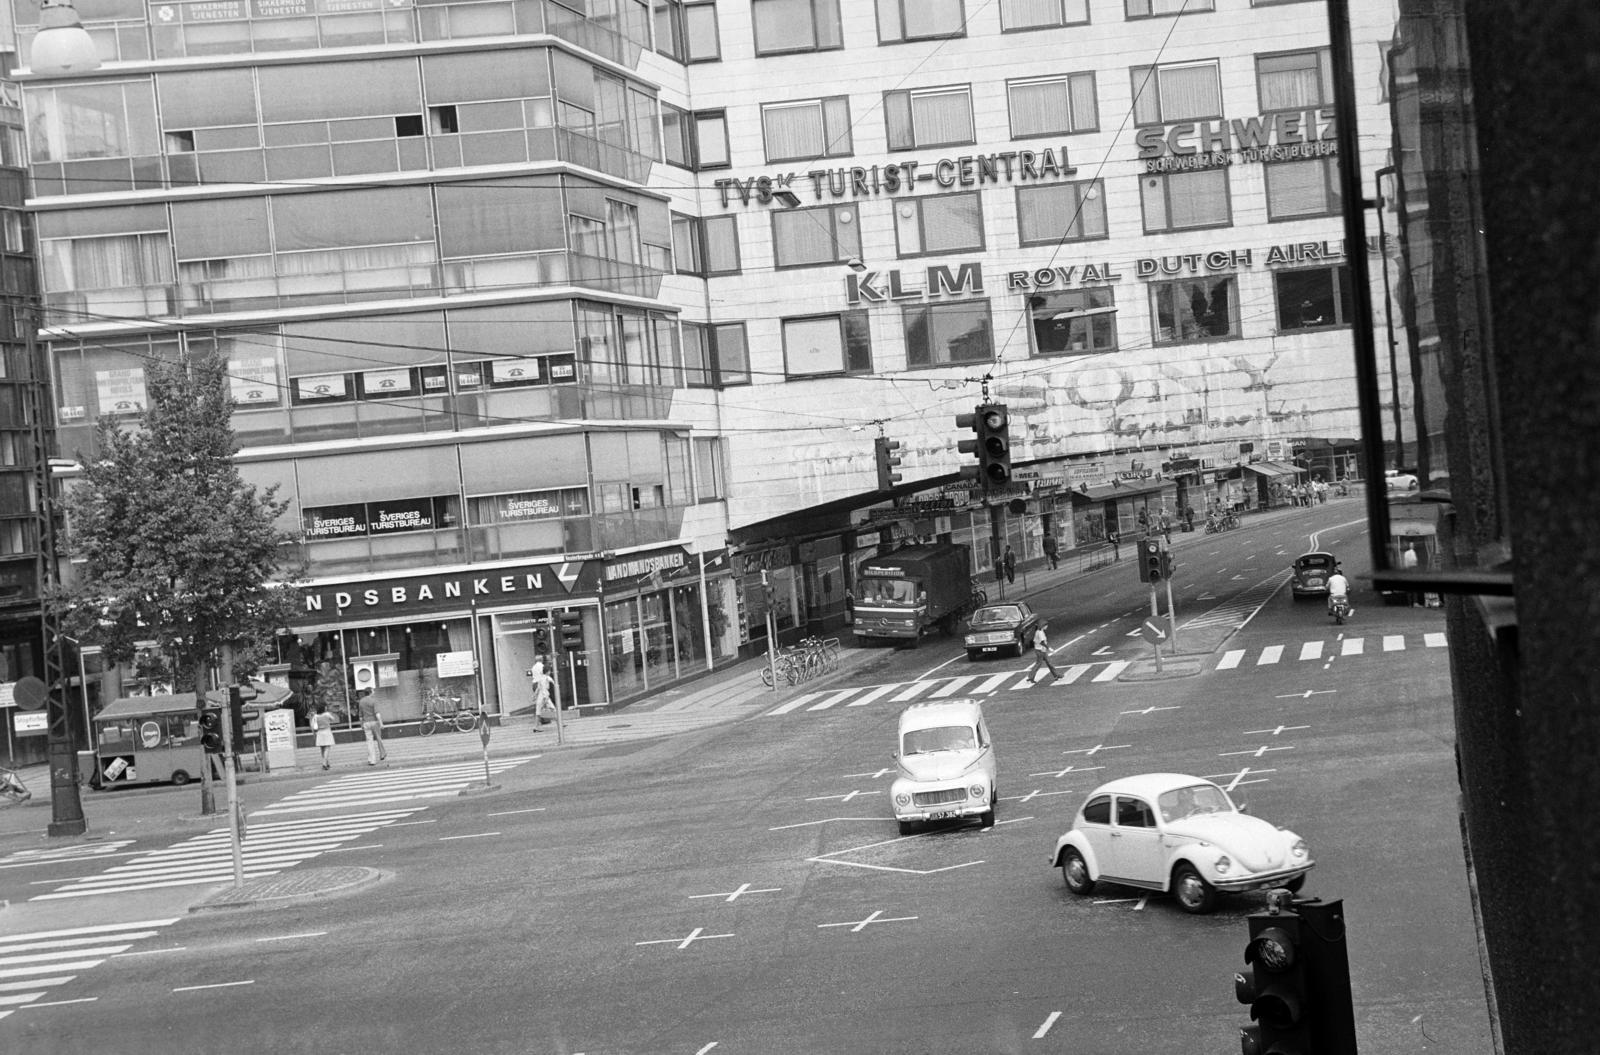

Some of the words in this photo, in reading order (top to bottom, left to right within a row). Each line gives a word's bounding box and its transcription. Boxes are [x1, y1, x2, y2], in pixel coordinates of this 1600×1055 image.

[1136, 110, 1338, 158] SCHWEIZ
[1147, 153, 1235, 172] SCHWEIZISK
[1241, 142, 1338, 164] TURISTBUREA
[714, 172, 796, 208] TYSK
[808, 145, 1078, 200] TURIST-CENTRAL
[844, 262, 985, 304] KLM
[1007, 262, 1122, 290] ROYAL
[1136, 248, 1253, 278] DUTCH
[499, 505, 560, 518] TURISTBUREAU
[508, 500, 549, 511] SVERIGES
[314, 517, 355, 528] SVERIGES
[380, 511, 421, 522] SVERIGES
[306, 524, 366, 536] TURISTBUREAU
[370, 518, 431, 530] TURISTBUREAU
